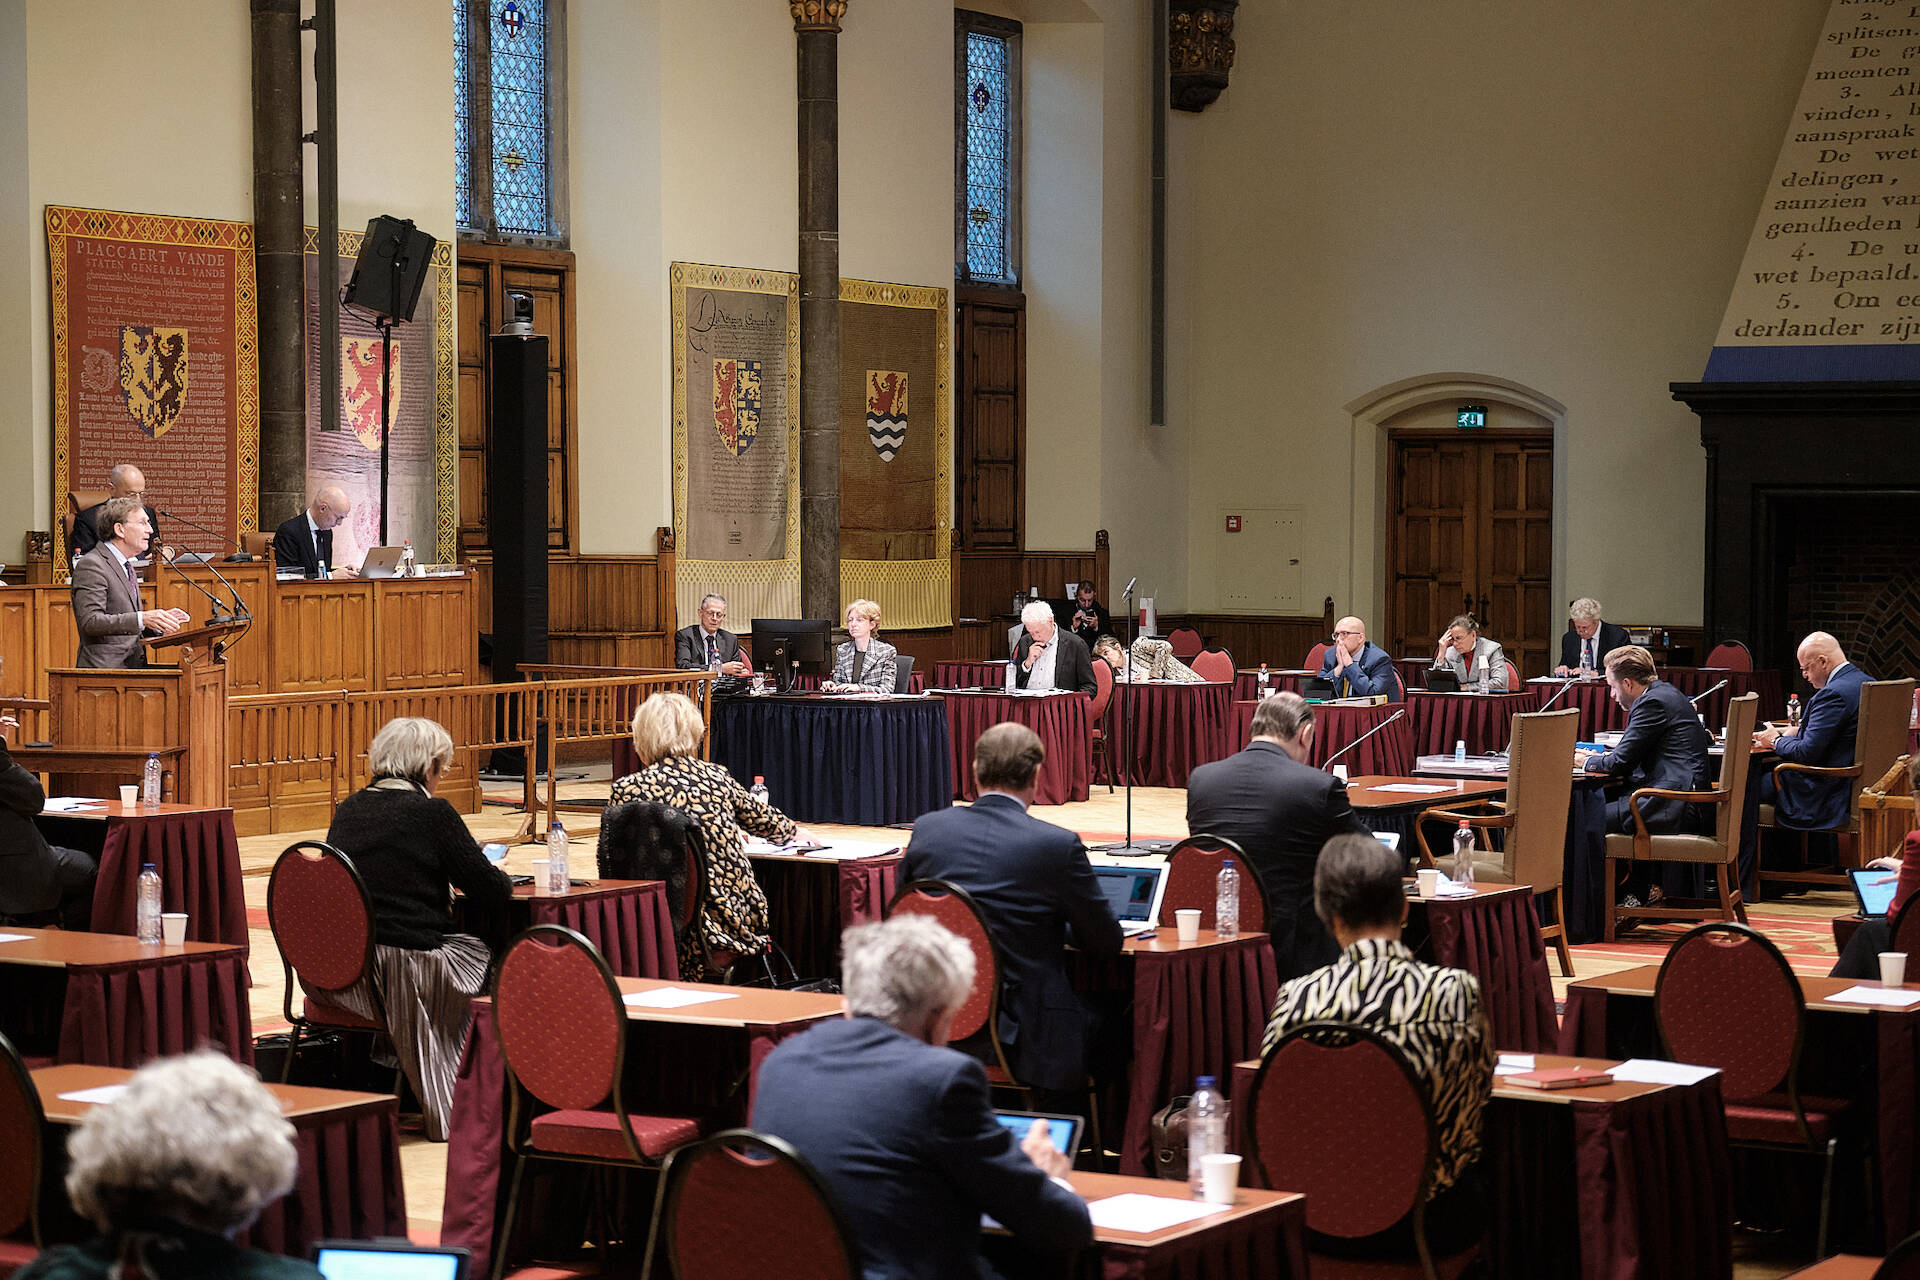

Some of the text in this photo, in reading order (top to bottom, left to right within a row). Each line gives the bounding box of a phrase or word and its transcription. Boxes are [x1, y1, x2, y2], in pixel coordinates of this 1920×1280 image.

[1850, 47, 1880, 58] De
[1815, 67, 1910, 80] meenten
[1840, 87, 1860, 98] 3.
[1795, 124, 1915, 145] aanspraak
[1818, 150, 1850, 163] De
[1782, 171, 1898, 190] delingen,
[1775, 193, 1866, 210] aanzien
[1766, 215, 1901, 239] gendheden
[76, 240, 225, 266] PLACCAERT VANDE
[1791, 243, 1814, 261] 4.
[1848, 241, 1884, 256] De
[131, 262, 188, 276] GENERAEL
[192, 268, 225, 278] VANDE
[1754, 263, 1918, 288] wet bepaald.
[1777, 293, 1799, 309] 5.
[1834, 292, 1879, 309] Om
[1735, 317, 1864, 336] derlander
